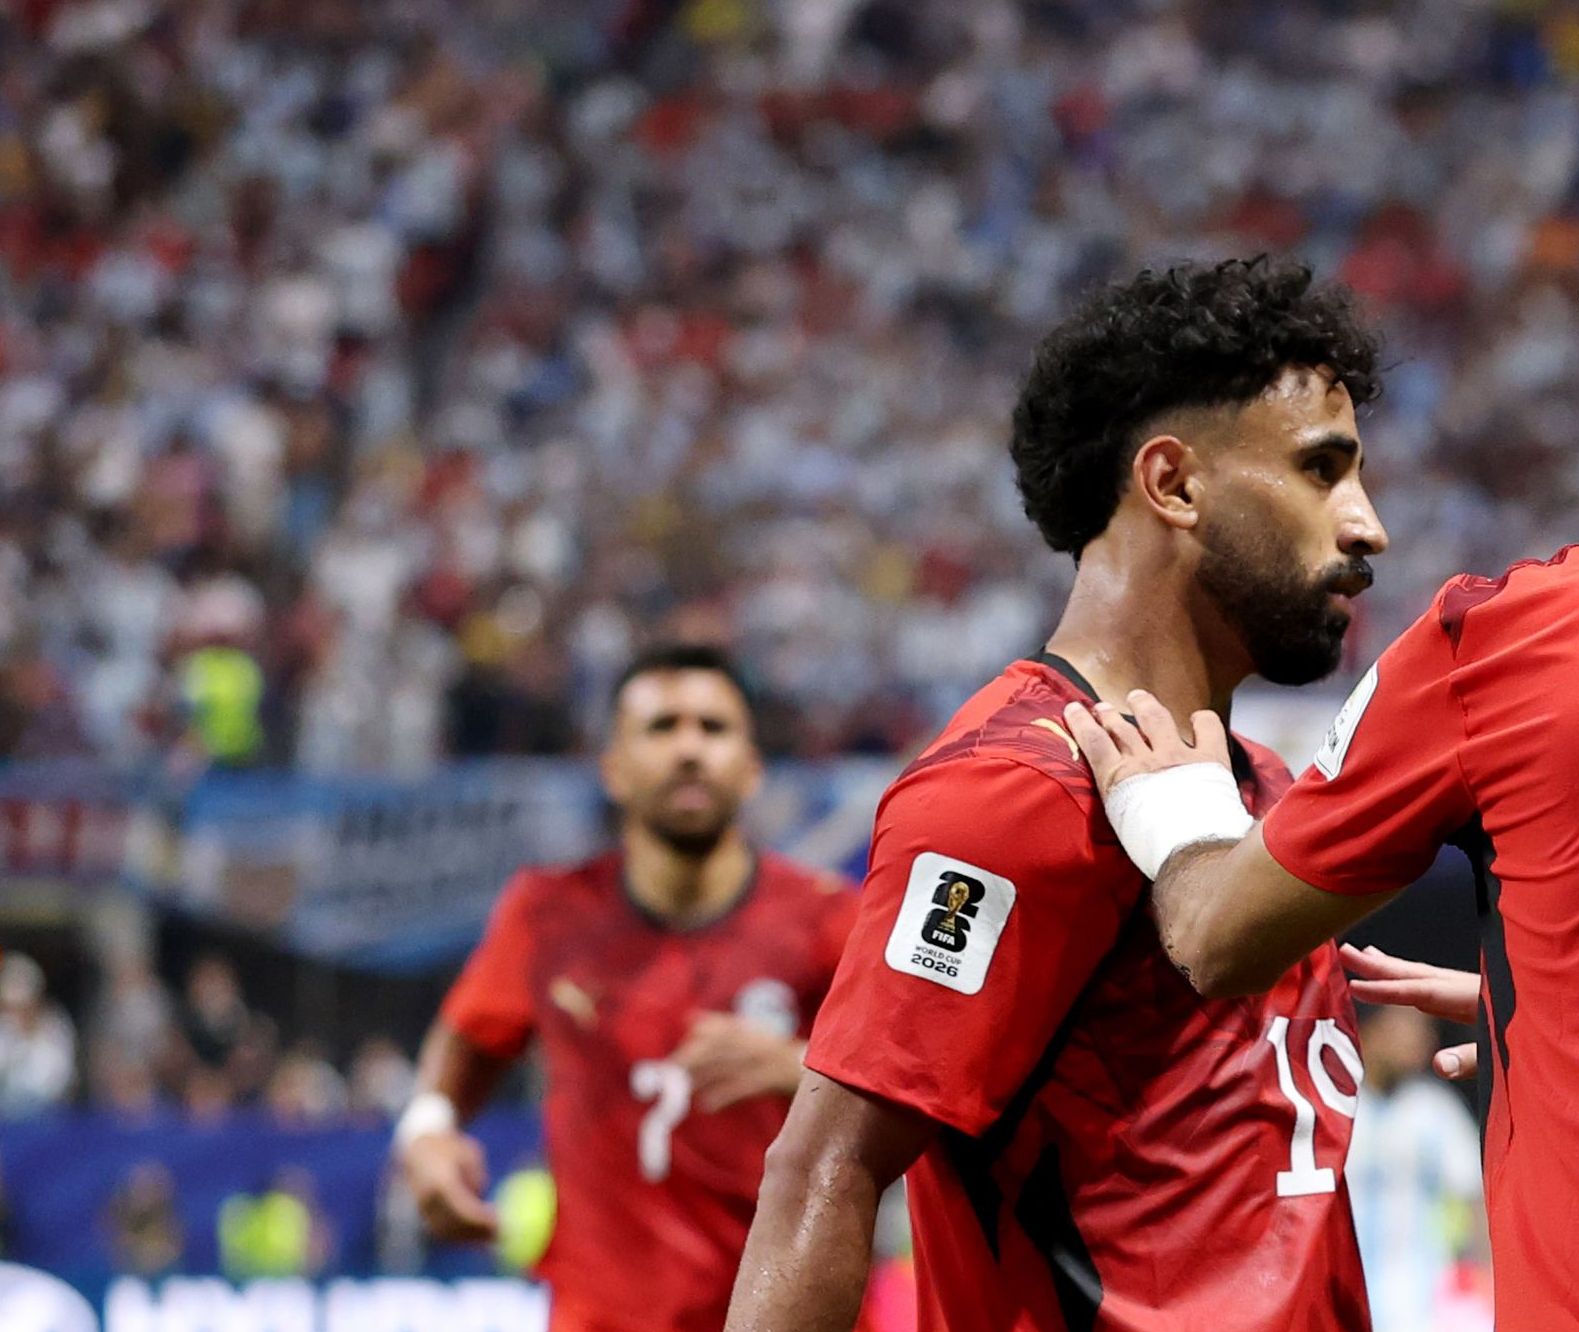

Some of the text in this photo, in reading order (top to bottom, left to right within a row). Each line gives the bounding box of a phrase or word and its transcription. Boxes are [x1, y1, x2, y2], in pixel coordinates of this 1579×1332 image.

[932, 930, 955, 946] FIFA
[911, 953, 959, 978] 2026
[915, 944, 962, 966] WORLD CUP
[629, 1061, 691, 1182] 7
